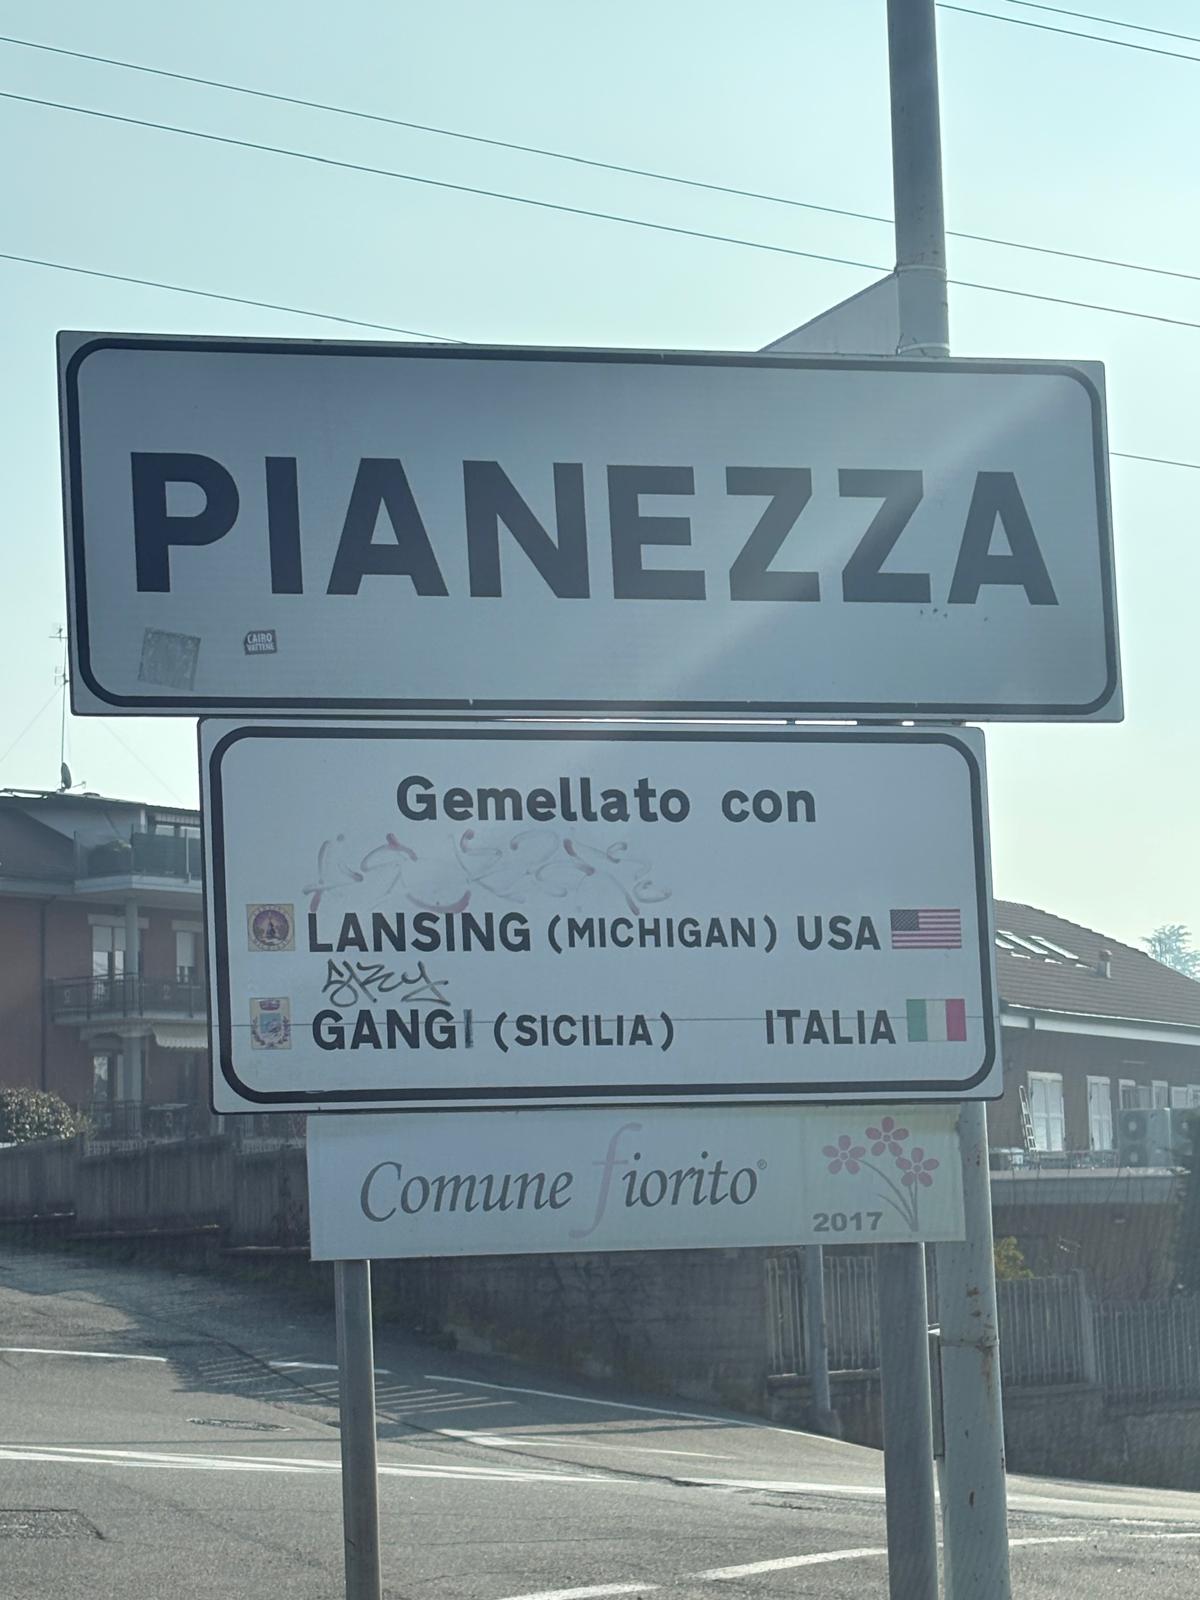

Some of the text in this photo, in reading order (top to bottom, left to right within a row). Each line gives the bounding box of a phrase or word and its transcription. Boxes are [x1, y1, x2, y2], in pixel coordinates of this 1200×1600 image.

[131, 453, 1057, 605] PIANEZZA
[247, 632, 273, 644] CAIRO
[397, 775, 816, 823] Gemellato con
[308, 912, 531, 953] LANSING
[548, 913, 777, 954] (MICHIGAN)
[797, 915, 881, 951] USA
[312, 1009, 896, 1053] GANGI (SICILIA) ITALIA
[361, 1160, 573, 1222] Comune
[813, 1211, 883, 1232] 2017
